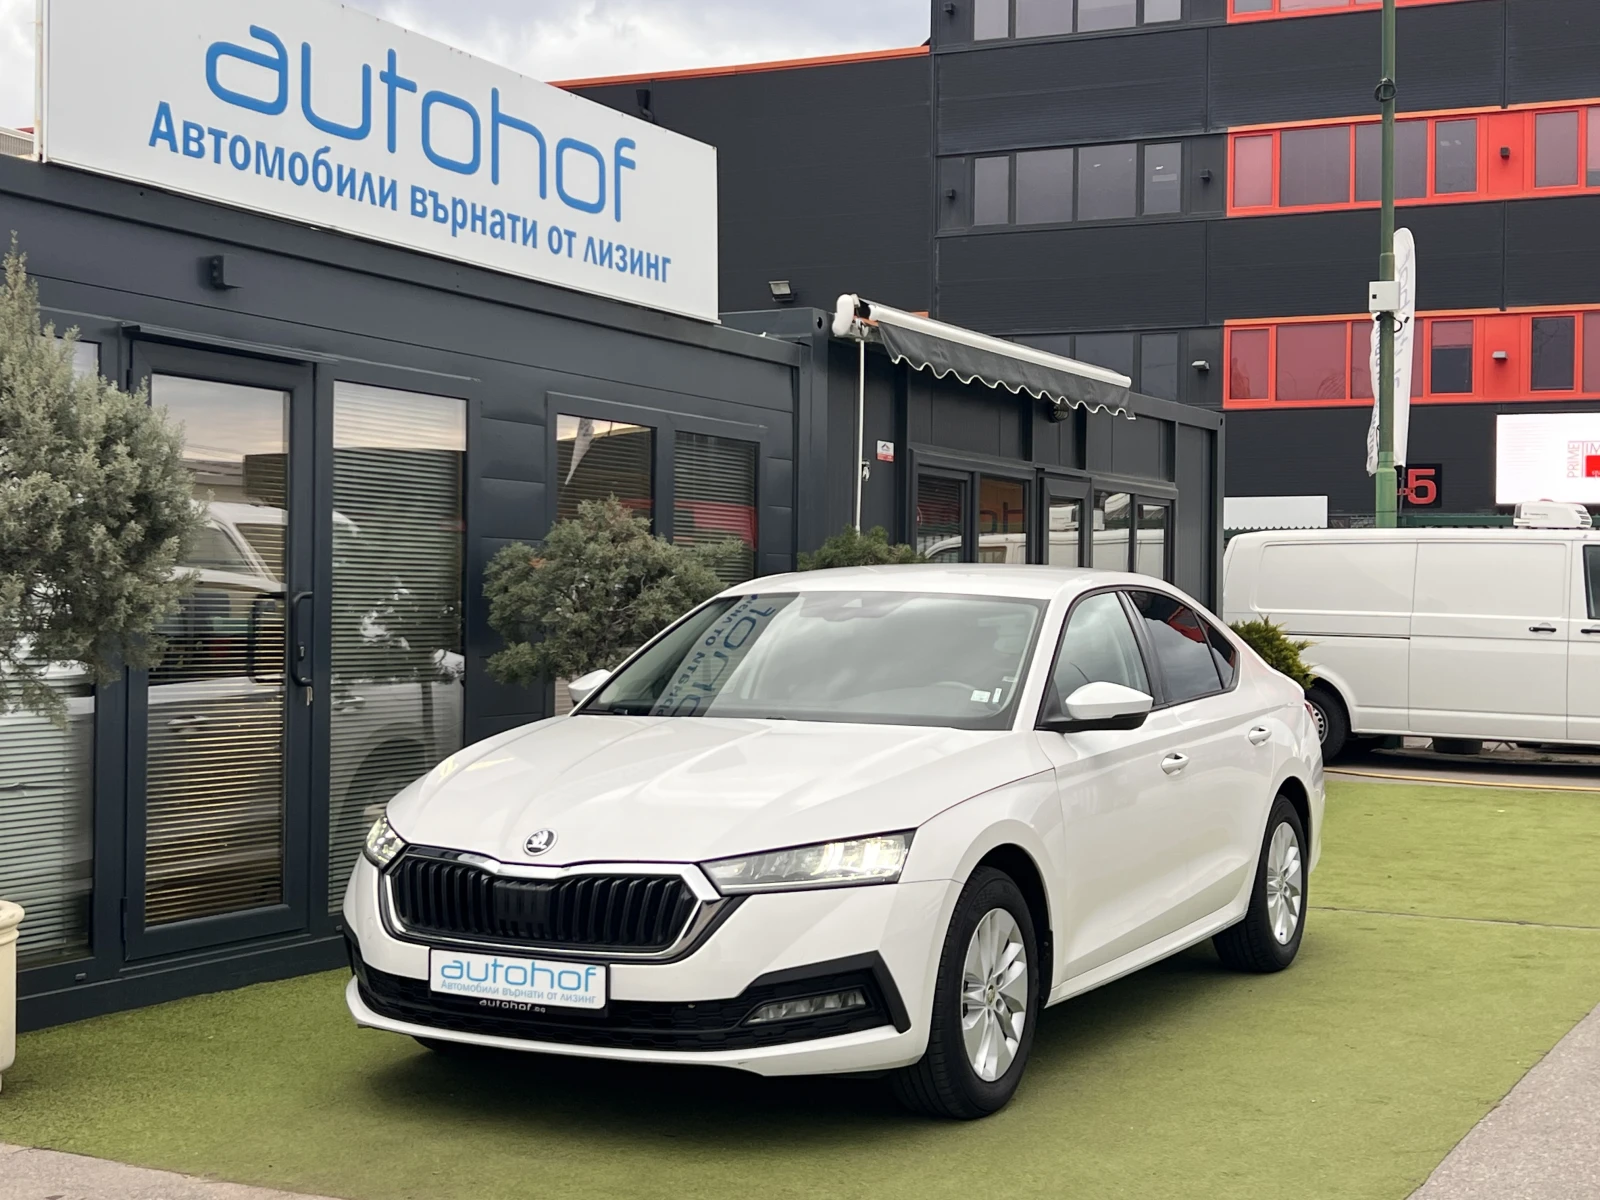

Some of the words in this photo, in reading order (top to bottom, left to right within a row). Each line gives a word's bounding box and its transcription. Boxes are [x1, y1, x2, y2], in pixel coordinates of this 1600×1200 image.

[205, 24, 637, 222] autohof
[148, 100, 397, 211] Автомобили
[410, 184, 538, 249] върнати
[547, 225, 577, 258] от
[583, 236, 672, 283] лизинг
[1567, 443, 1580, 478] PRIME
[1408, 468, 1437, 504] 5
[441, 958, 597, 992] autohof
[441, 979, 500, 995] Автомобили
[502, 987, 544, 999] върнати
[547, 991, 558, 1001] от
[560, 993, 597, 1004] лизинг
